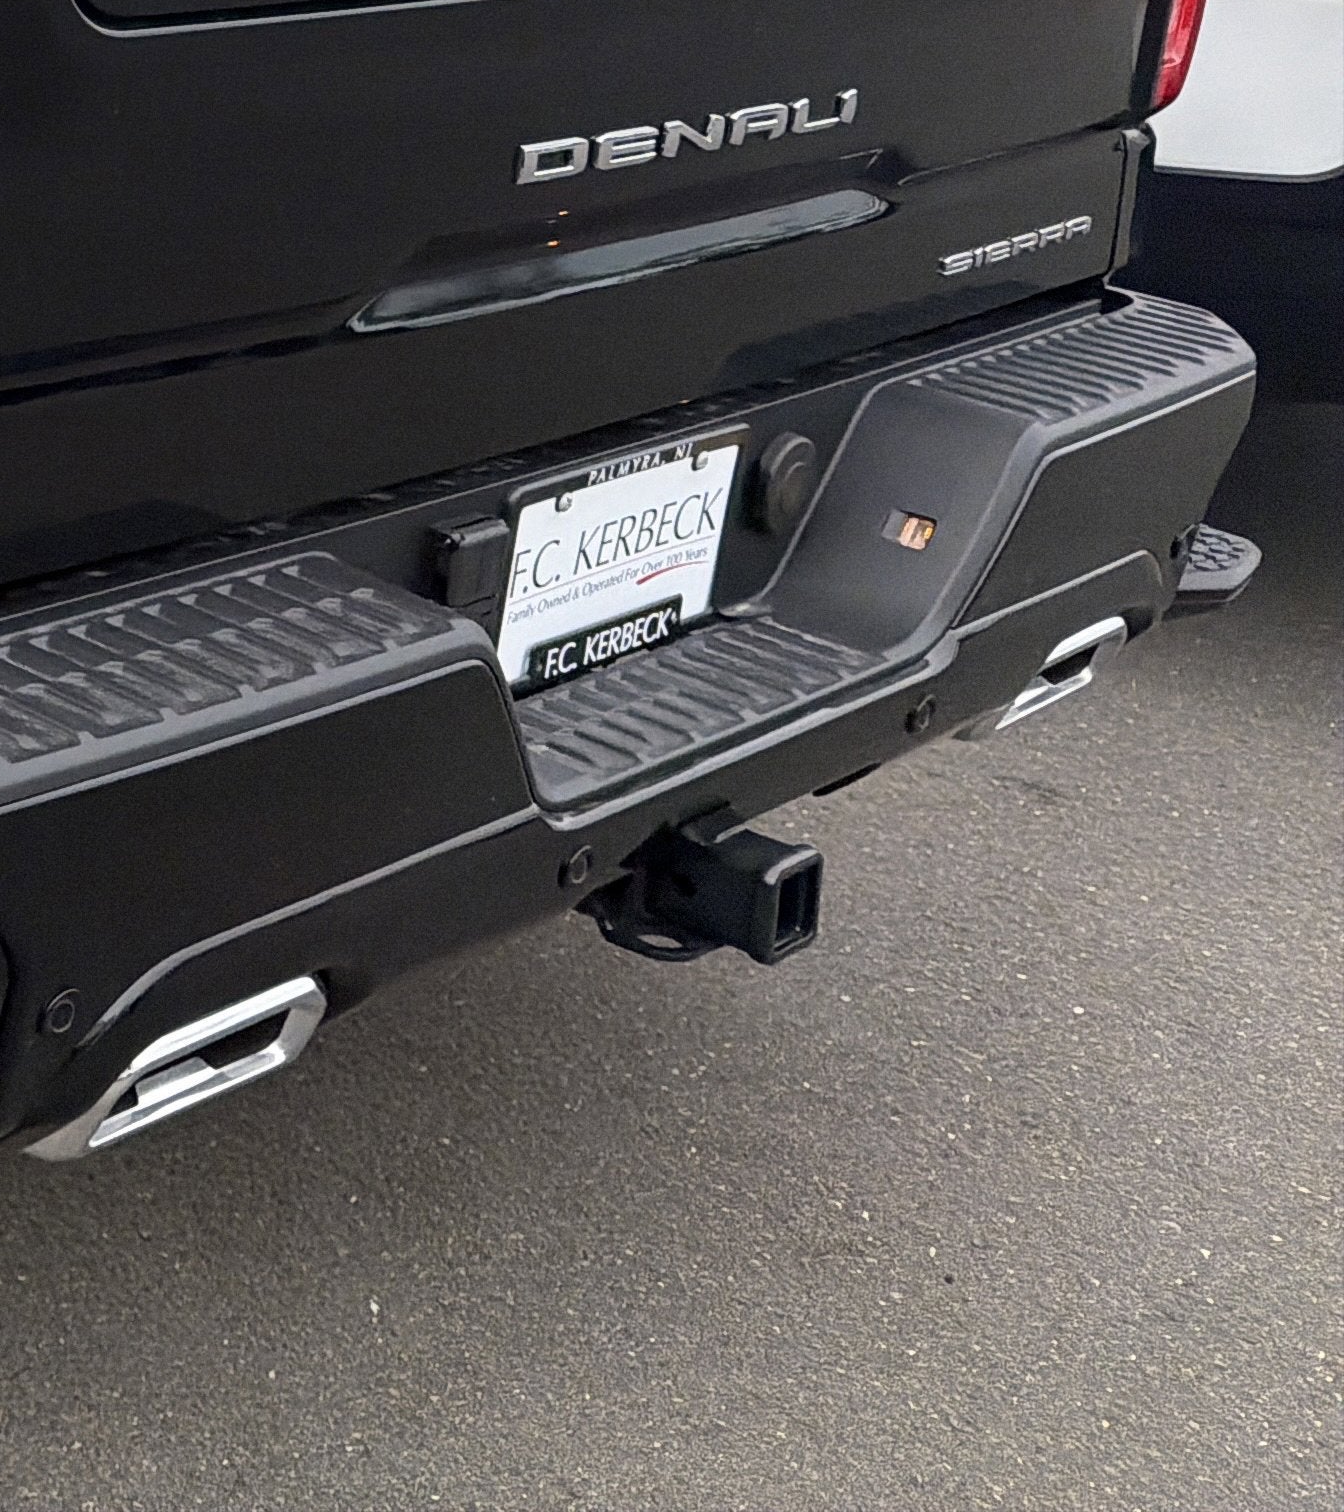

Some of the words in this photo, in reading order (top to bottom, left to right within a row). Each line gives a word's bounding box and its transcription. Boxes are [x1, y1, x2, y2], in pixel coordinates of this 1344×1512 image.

[515, 88, 858, 185] DENALI
[936, 215, 1093, 276] SIERRA
[510, 539, 561, 598] F.C.
[573, 487, 724, 575] KERBECK
[506, 605, 535, 625] Family
[537, 588, 572, 614] Owned
[581, 569, 625, 598] Operated
[625, 567, 640, 582] For
[641, 558, 664, 577] Over
[665, 553, 683, 567] 100
[684, 546, 709, 562] Years
[583, 607, 671, 666] KERBECK
